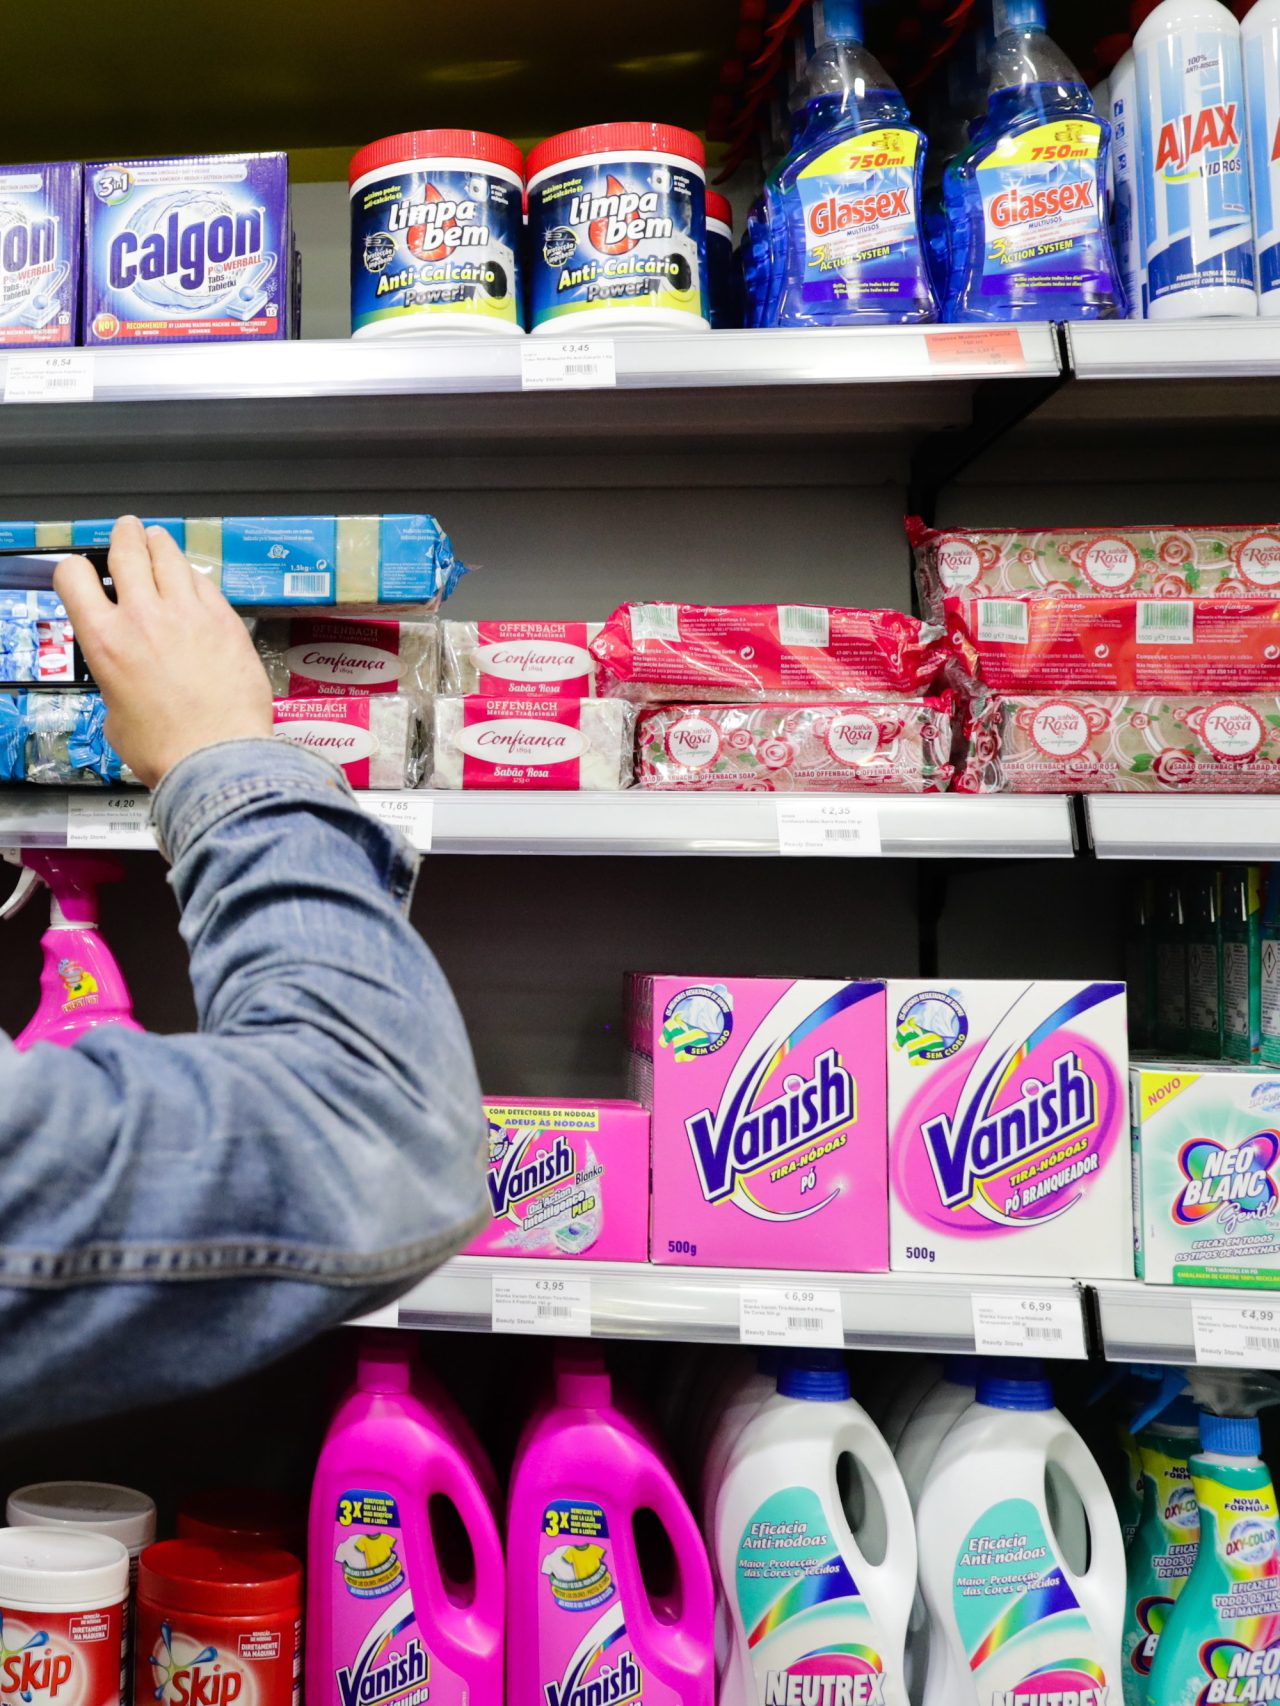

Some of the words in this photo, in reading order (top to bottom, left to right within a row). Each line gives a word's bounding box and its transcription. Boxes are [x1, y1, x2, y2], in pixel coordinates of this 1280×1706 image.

[1187, 54, 1207, 66] 100%
[1154, 103, 1239, 172] AJAX
[849, 152, 905, 170] 750ml
[1031, 144, 1089, 161] 750ml
[1199, 158, 1241, 178] VIDROS
[569, 192, 659, 226] limpa
[809, 188, 910, 237] Glassex
[989, 180, 1091, 228] Glassex
[388, 199, 476, 232] limpa
[423, 222, 489, 251] bem
[604, 215, 673, 245] bem
[109, 211, 262, 290] Calgon
[1037, 239, 1073, 256] SYSTEM
[376, 262, 495, 296] Anti-Calcário
[557, 255, 680, 293] Anti-Calcário
[403, 286, 465, 307] Power!
[587, 279, 650, 302] Power!
[1089, 551, 1129, 570] Rosa
[499, 623, 566, 633] OFFENBACH
[526, 631, 566, 639] Tradicional
[302, 651, 385, 673] Confiança
[491, 650, 575, 672] Confiança
[318, 684, 346, 696] Sabão
[508, 682, 537, 694] Sabão
[539, 683, 561, 694] Rosa
[277, 703, 347, 713] OFFENBACH
[486, 701, 558, 711] OFFENBACH
[514, 709, 558, 717] Tradicional
[833, 725, 873, 745] Rosa
[1036, 715, 1079, 736] Rosa
[1207, 715, 1252, 736] Rosa
[477, 730, 567, 754] Confiança
[673, 730, 712, 749] Rosa
[493, 766, 523, 778] Sabão
[527, 767, 550, 778] Rosa
[1002, 763, 1025, 771] SABÃO
[1026, 762, 1066, 771] OFFENBACH
[1075, 762, 1098, 771] SABÃO
[115, 799, 135, 809] 4,20
[389, 801, 409, 811] 1,65
[828, 806, 851, 816] 2,35
[690, 1047, 709, 1056] SEM
[709, 1029, 730, 1052] CLORO
[925, 1048, 943, 1060] SEM
[943, 1032, 966, 1058] CLORO
[1147, 1077, 1182, 1107] NOVO
[505, 1118, 536, 1127] ADEUS
[508, 1109, 551, 1117] DETECTORES
[685, 1047, 857, 1204] Vanish
[920, 1050, 1098, 1211] Vanish
[770, 1133, 848, 1183] TIRA-NÓDOAS
[1008, 1137, 1089, 1188] TIRA-NÓDOAS
[1202, 1145, 1256, 1179] NEO
[486, 1136, 575, 1218] Vanish
[800, 1165, 816, 1195] PÓ
[1004, 1190, 1020, 1217] PÓ
[1022, 1152, 1100, 1212] BRANQUEADOR
[1182, 1169, 1267, 1207] BLANC
[572, 1195, 596, 1219] PLUS
[1217, 1196, 1278, 1234] Gentil
[667, 1240, 698, 1257] 500g
[1192, 1238, 1226, 1250] EFICAZ
[1227, 1236, 1241, 1247] EM
[1241, 1234, 1274, 1246] TODOS
[905, 1246, 936, 1262] 500g
[1175, 1252, 1188, 1263] OS
[1188, 1250, 1218, 1262] TIPOS
[1219, 1249, 1233, 1259] DE
[1233, 1245, 1280, 1257] MANCHAS
[543, 1281, 564, 1291] 3,95
[792, 1292, 814, 1302] 6,99
[1028, 1302, 1052, 1312] 6,99
[1249, 1310, 1274, 1321] 4,99
[750, 1520, 808, 1538] Eficácia
[741, 1531, 828, 1550] Anti-nódoas
[968, 1533, 1028, 1553] Eficácia
[1225, 1528, 1276, 1556] OXY-COLOR
[738, 1559, 767, 1570] Maior
[768, 1557, 819, 1571] Protecção
[959, 1544, 1047, 1567] Anti-nódoas
[1153, 1556, 1185, 1567] TODOS
[743, 1567, 761, 1578] das
[762, 1567, 792, 1578] Cores
[803, 1562, 841, 1577] Tecidos
[956, 1576, 987, 1588] Maior
[988, 1571, 1040, 1587] Protecção
[962, 1586, 980, 1597] das
[981, 1584, 1011, 1597] Cores
[1024, 1576, 1061, 1592] Tecidos
[1232, 1581, 1262, 1595] EFICAZ
[1214, 1594, 1247, 1607] TODOS
[1221, 1608, 1236, 1619] DE
[71, 1625, 108, 1635] DIRETAMENTE
[73, 1633, 82, 1641] NA
[82, 1631, 106, 1640] MÁQUINA
[241, 1641, 278, 1651] DIRETAMENTE
[243, 1650, 252, 1658] NA
[252, 1648, 276, 1657] MÁQUINA
[0, 1647, 72, 1698] Skip
[335, 1637, 430, 1706] Vanish
[1227, 1647, 1280, 1678] NEO
[170, 1664, 242, 1706] Skip
[543, 1650, 641, 1706] Vanish
[765, 1669, 888, 1706] NEUTREX
